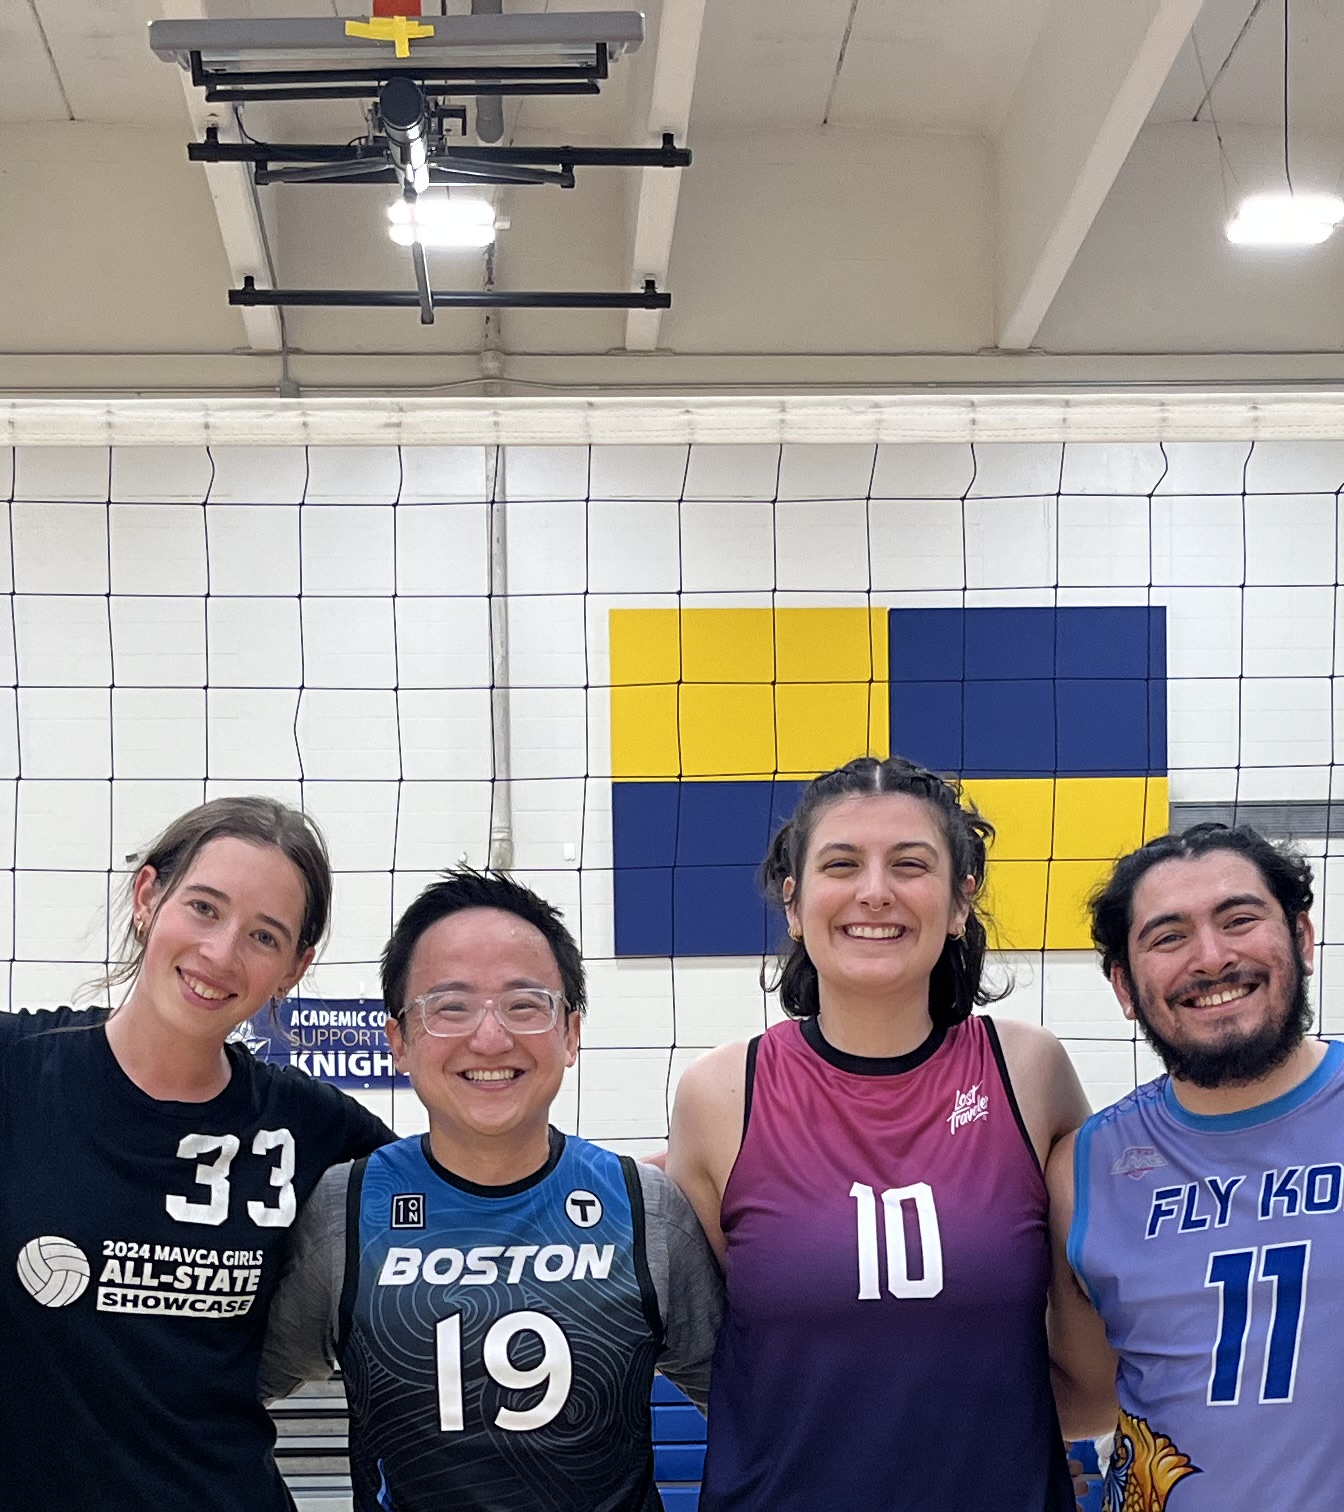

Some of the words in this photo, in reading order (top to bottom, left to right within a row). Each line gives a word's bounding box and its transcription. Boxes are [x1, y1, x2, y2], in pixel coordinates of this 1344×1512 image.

[290, 1010, 367, 1027] ACADEMIC
[368, 1011, 391, 1027] CO
[290, 1051, 399, 1077] KNIGH
[955, 1080, 983, 1110] Lost
[166, 1128, 297, 1228] 33
[571, 1198, 595, 1222] T
[1144, 1175, 1246, 1239] FLY
[102, 1240, 150, 1259] 2024
[154, 1245, 219, 1265] MAVCA
[222, 1250, 263, 1266] GIRLS
[849, 1181, 943, 1300] 10
[99, 1259, 261, 1292] ALL-STATE
[378, 1244, 615, 1286] BOSTON
[102, 1292, 250, 1313] SHOWCASE
[1204, 1240, 1312, 1406] 11
[436, 1311, 572, 1431] 19
